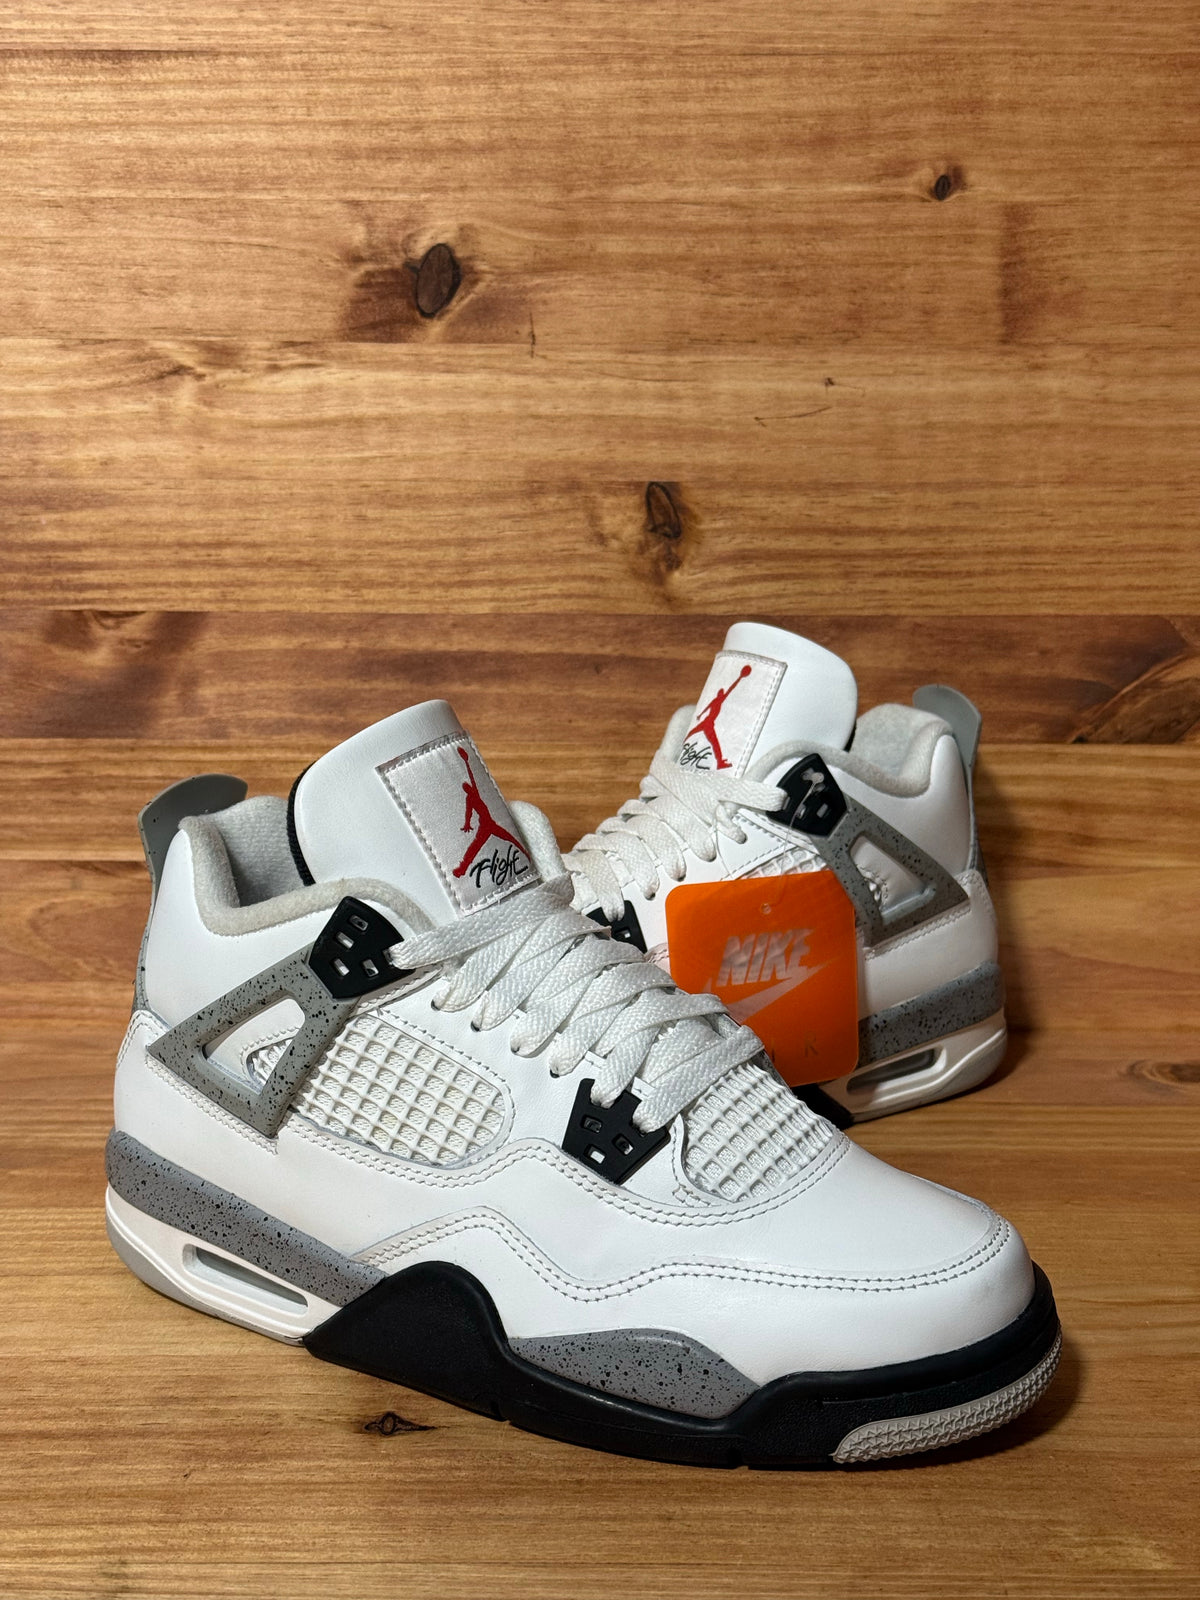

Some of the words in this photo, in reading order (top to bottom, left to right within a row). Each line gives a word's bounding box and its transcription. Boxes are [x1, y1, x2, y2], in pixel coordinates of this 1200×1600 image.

[680, 741, 712, 770] Flight
[469, 844, 528, 888] Flight
[715, 927, 816, 988] NIKE
[770, 1030, 819, 1064] IR
